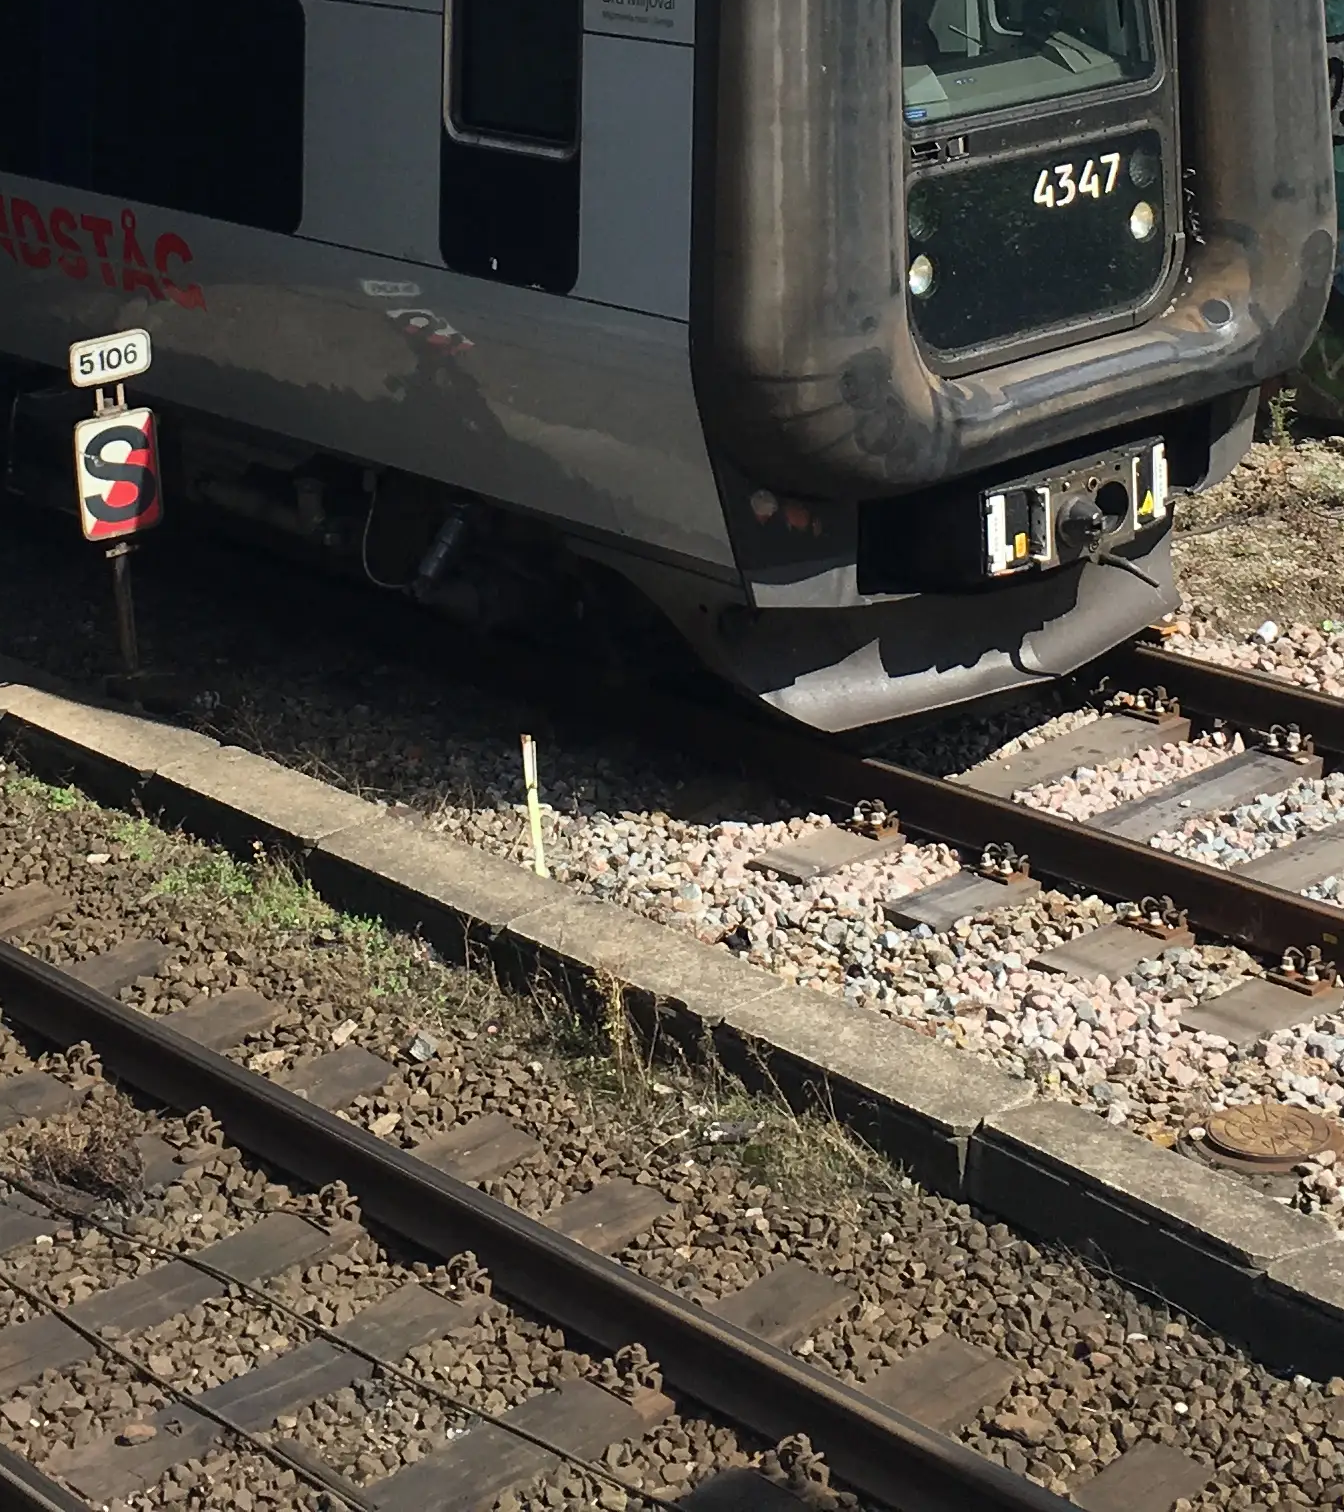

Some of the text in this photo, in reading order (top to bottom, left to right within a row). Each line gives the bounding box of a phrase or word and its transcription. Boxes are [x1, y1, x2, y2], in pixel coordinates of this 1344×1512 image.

[1032, 152, 1121, 208] 4347
[79, 342, 138, 376] 5106
[84, 424, 156, 523] S
